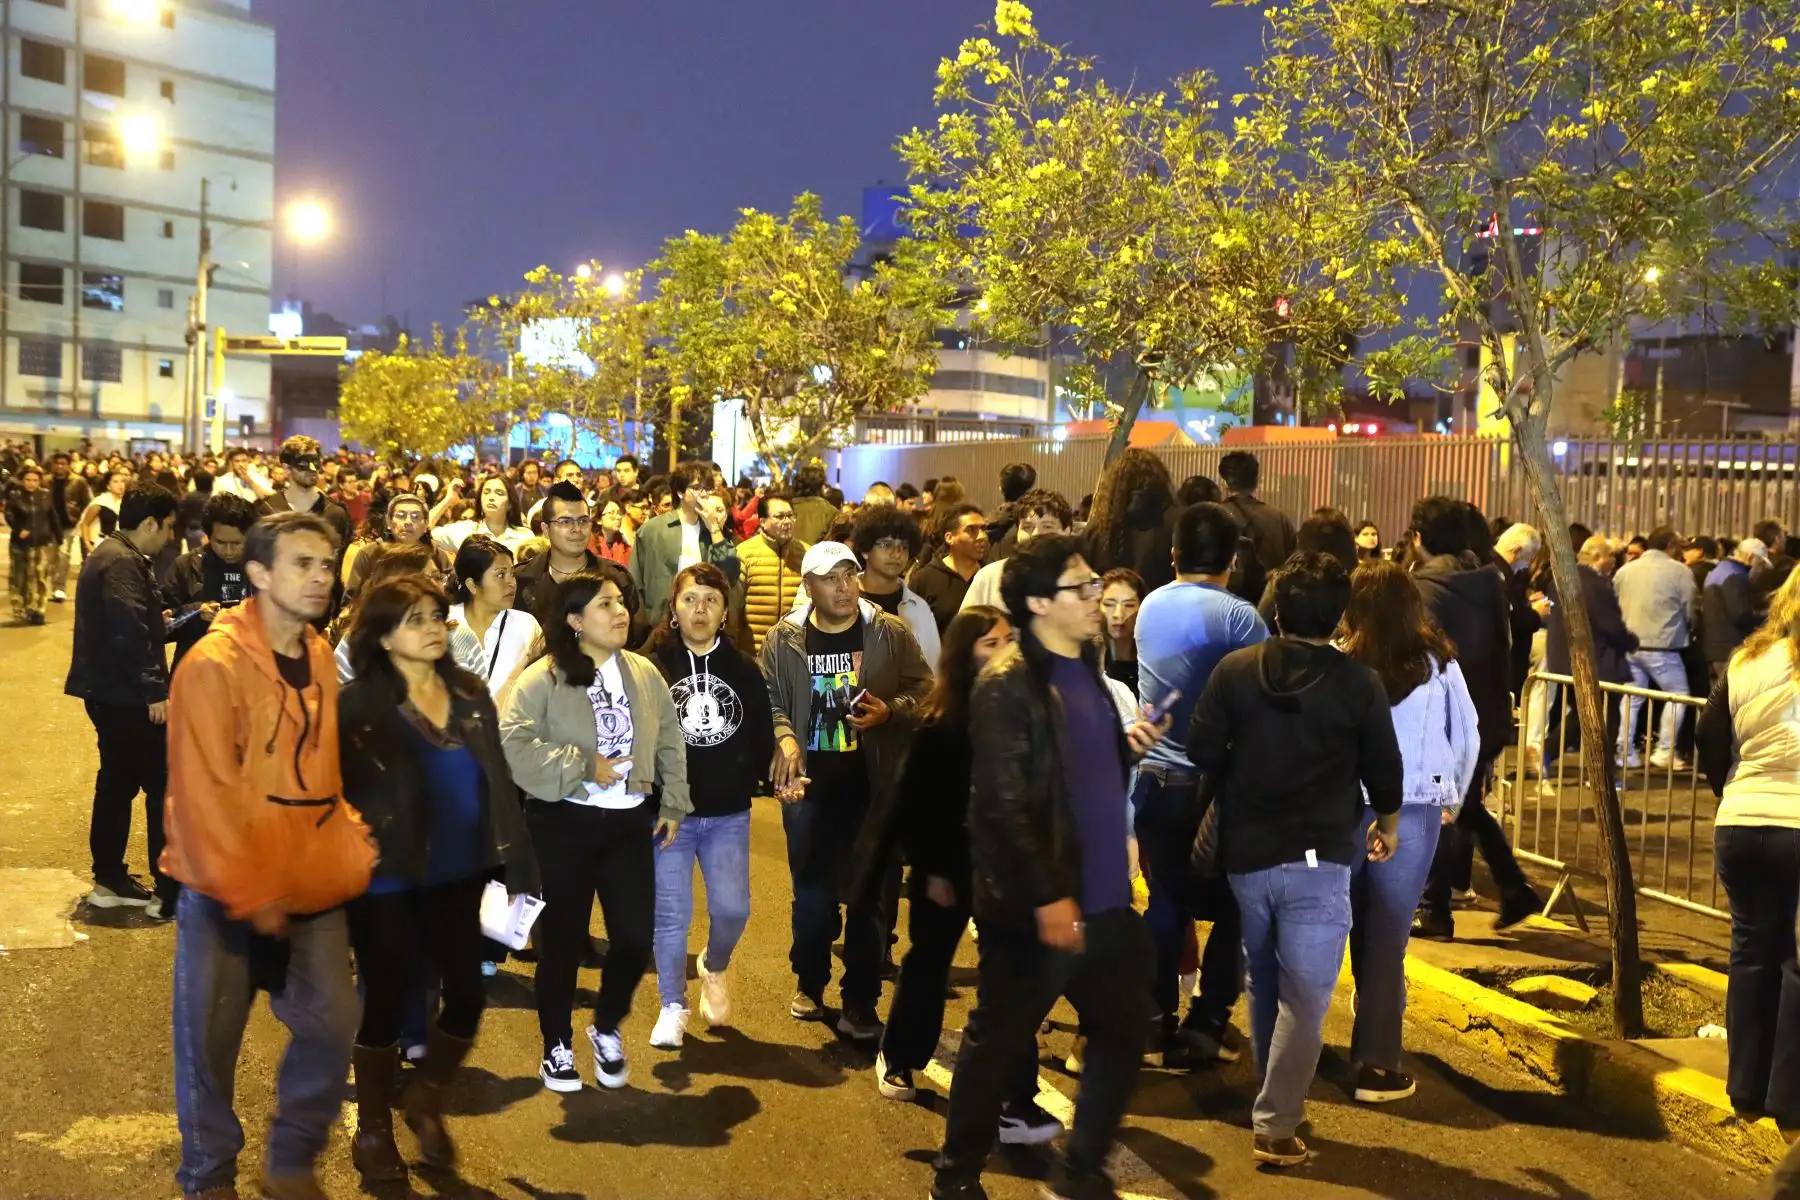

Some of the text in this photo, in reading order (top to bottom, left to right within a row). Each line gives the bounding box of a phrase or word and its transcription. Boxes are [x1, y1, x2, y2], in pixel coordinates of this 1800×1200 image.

[224, 572, 241, 582] THE
[815, 652, 851, 674] BEATLES
[705, 722, 737, 744] MOUSE
